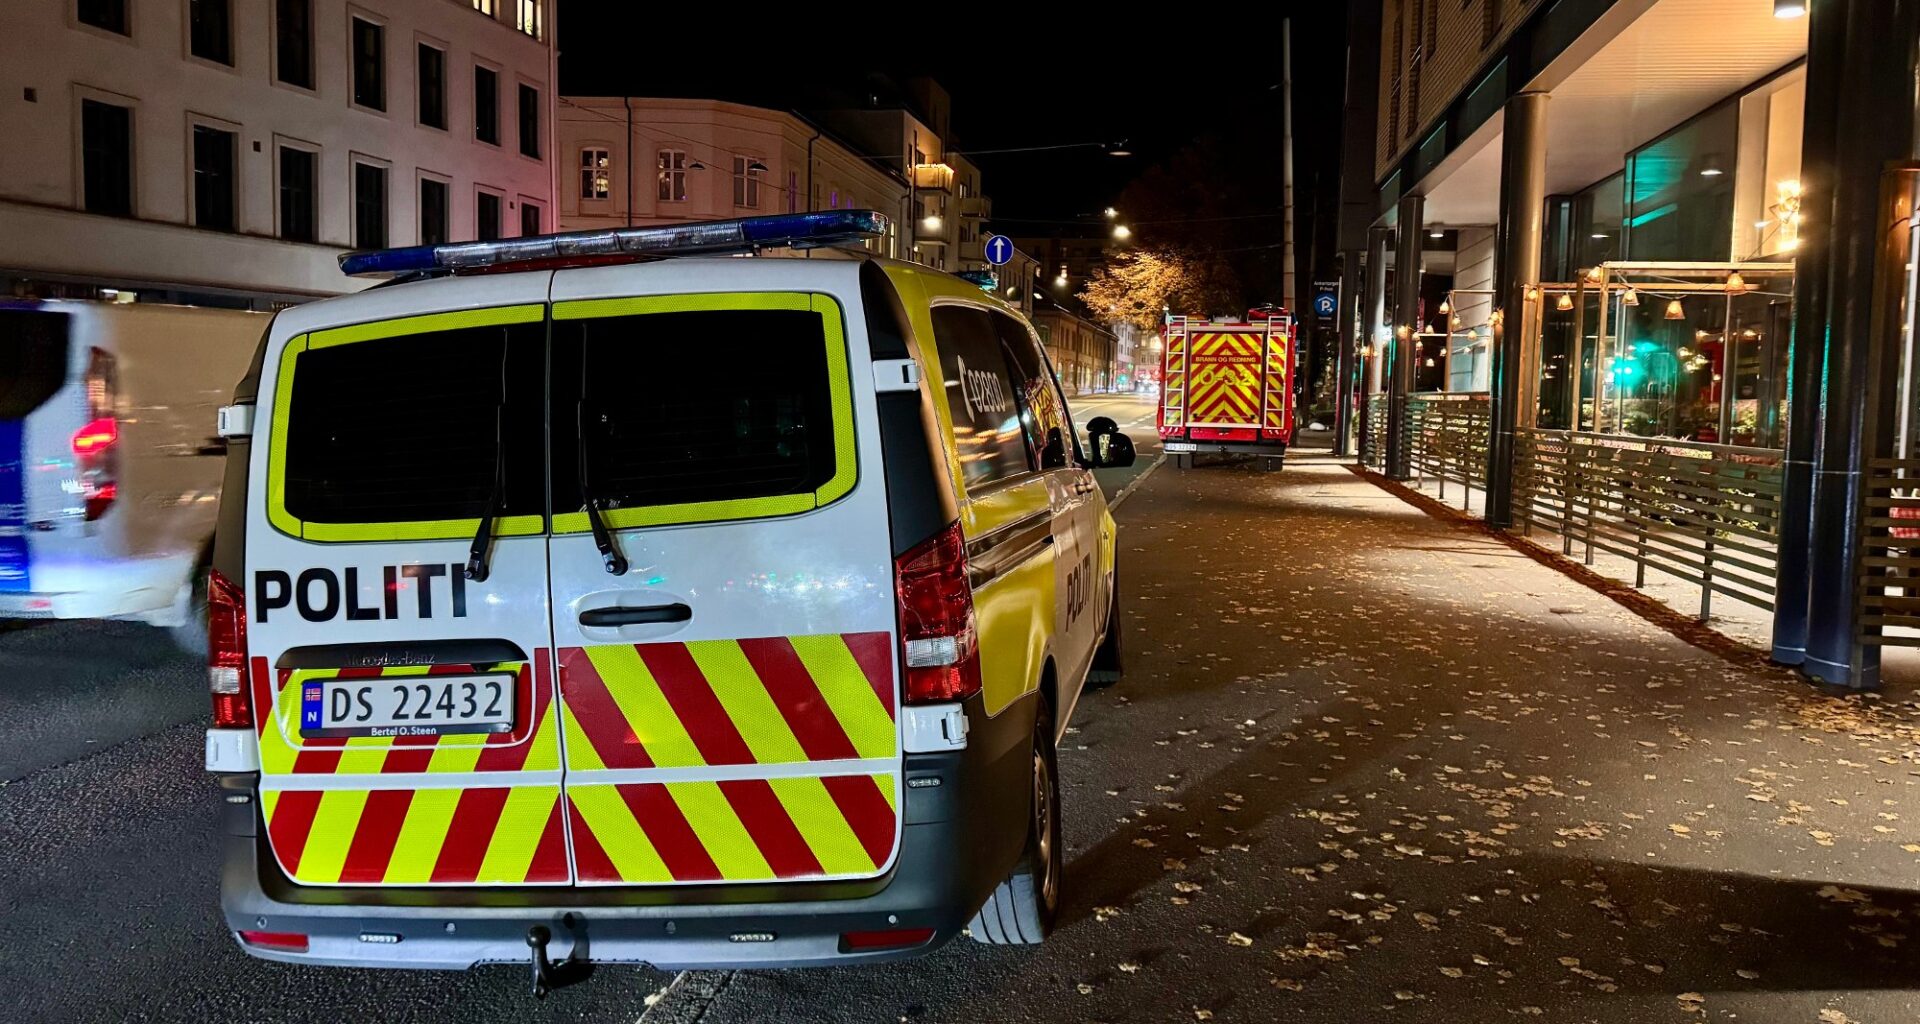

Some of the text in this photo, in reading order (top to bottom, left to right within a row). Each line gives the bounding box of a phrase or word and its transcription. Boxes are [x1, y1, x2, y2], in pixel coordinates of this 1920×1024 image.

[967, 369, 1006, 413] 02800
[255, 563, 467, 623] POLITI
[1065, 552, 1091, 632] POLITI
[307, 711, 318, 722] N
[331, 681, 502, 722] DS 22432
[371, 726, 437, 736] Bertel O. Steen
